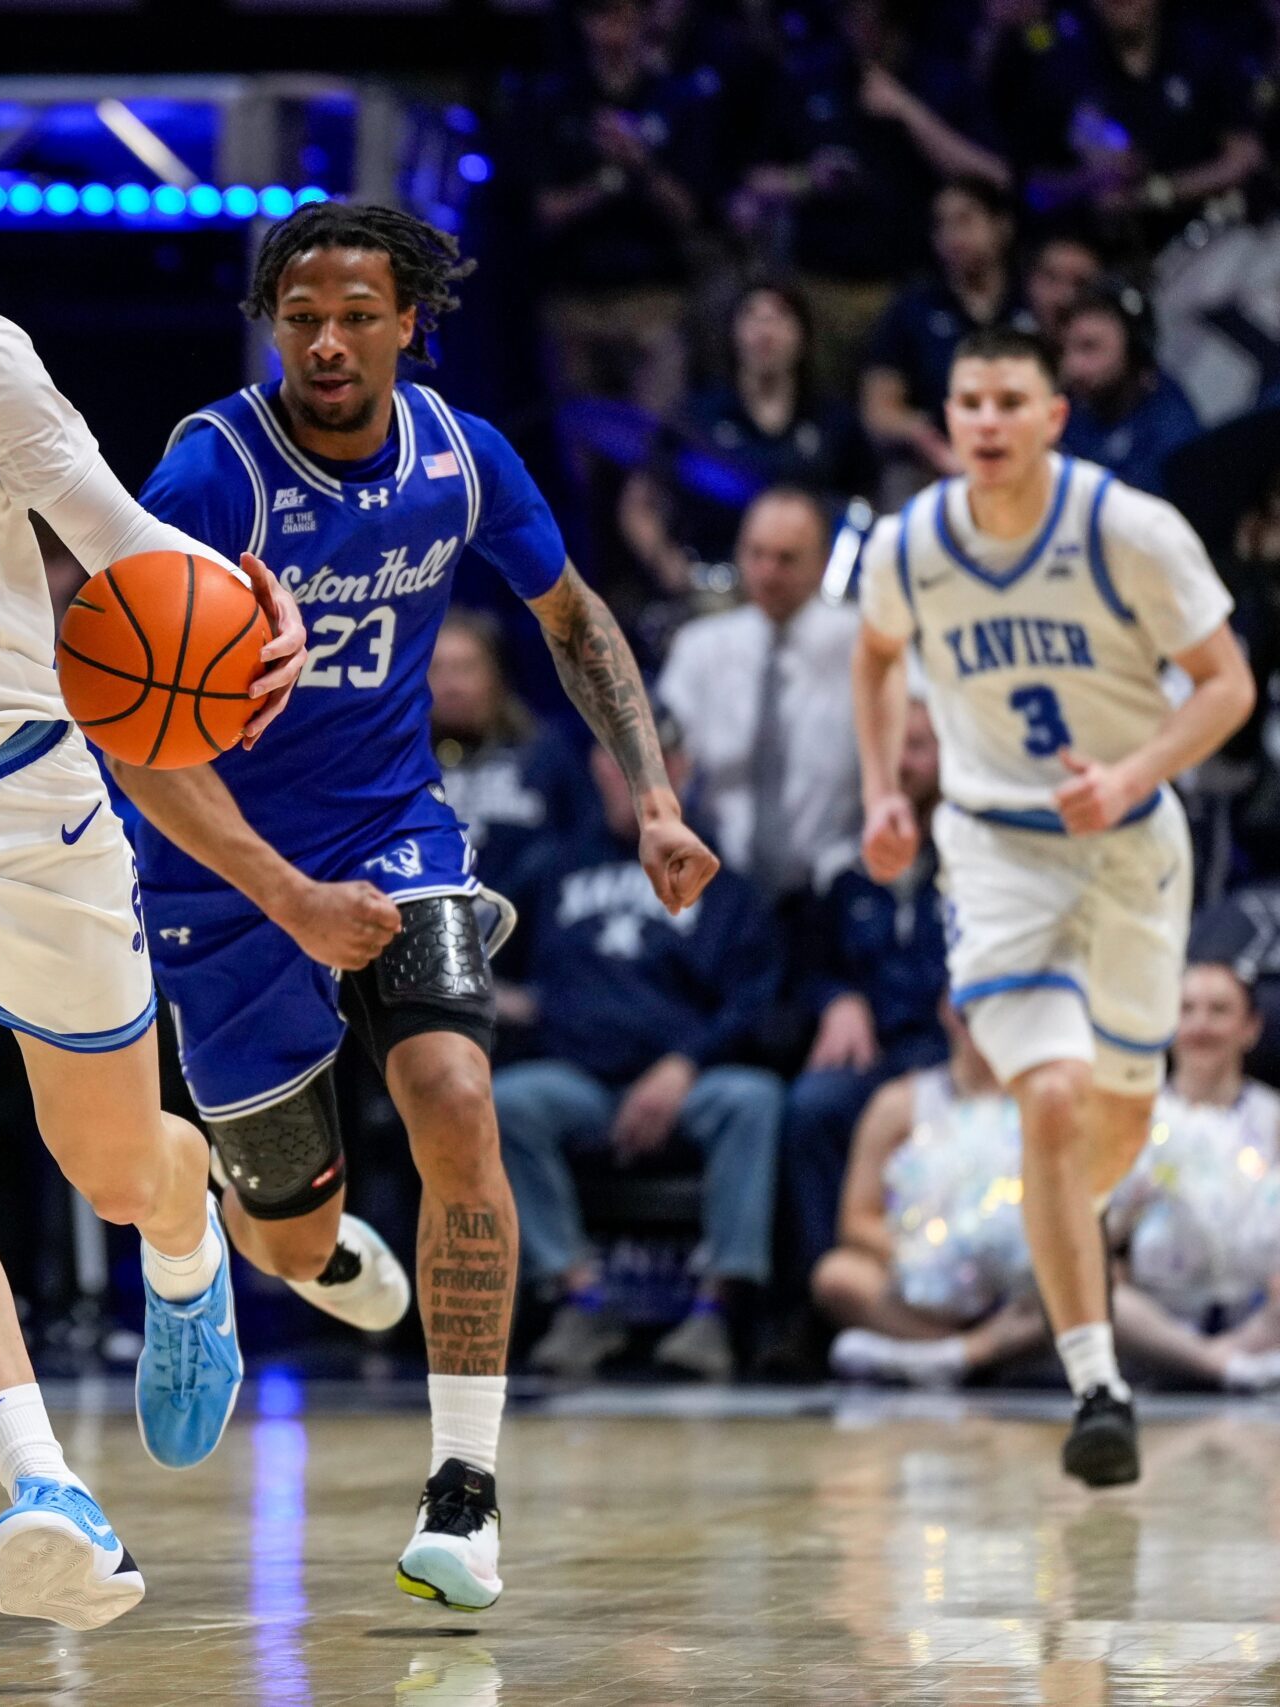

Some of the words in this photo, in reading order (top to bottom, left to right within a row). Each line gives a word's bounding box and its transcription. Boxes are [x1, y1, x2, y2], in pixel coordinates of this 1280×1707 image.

[282, 520, 317, 534] CHANGE
[296, 510, 314, 522] THE
[279, 565, 371, 605] Seton
[370, 536, 458, 600] Hall
[296, 605, 397, 689] 23
[944, 616, 1095, 678] XAVIER
[1008, 683, 1073, 757] 3
[446, 1212, 495, 1240] PAIN
